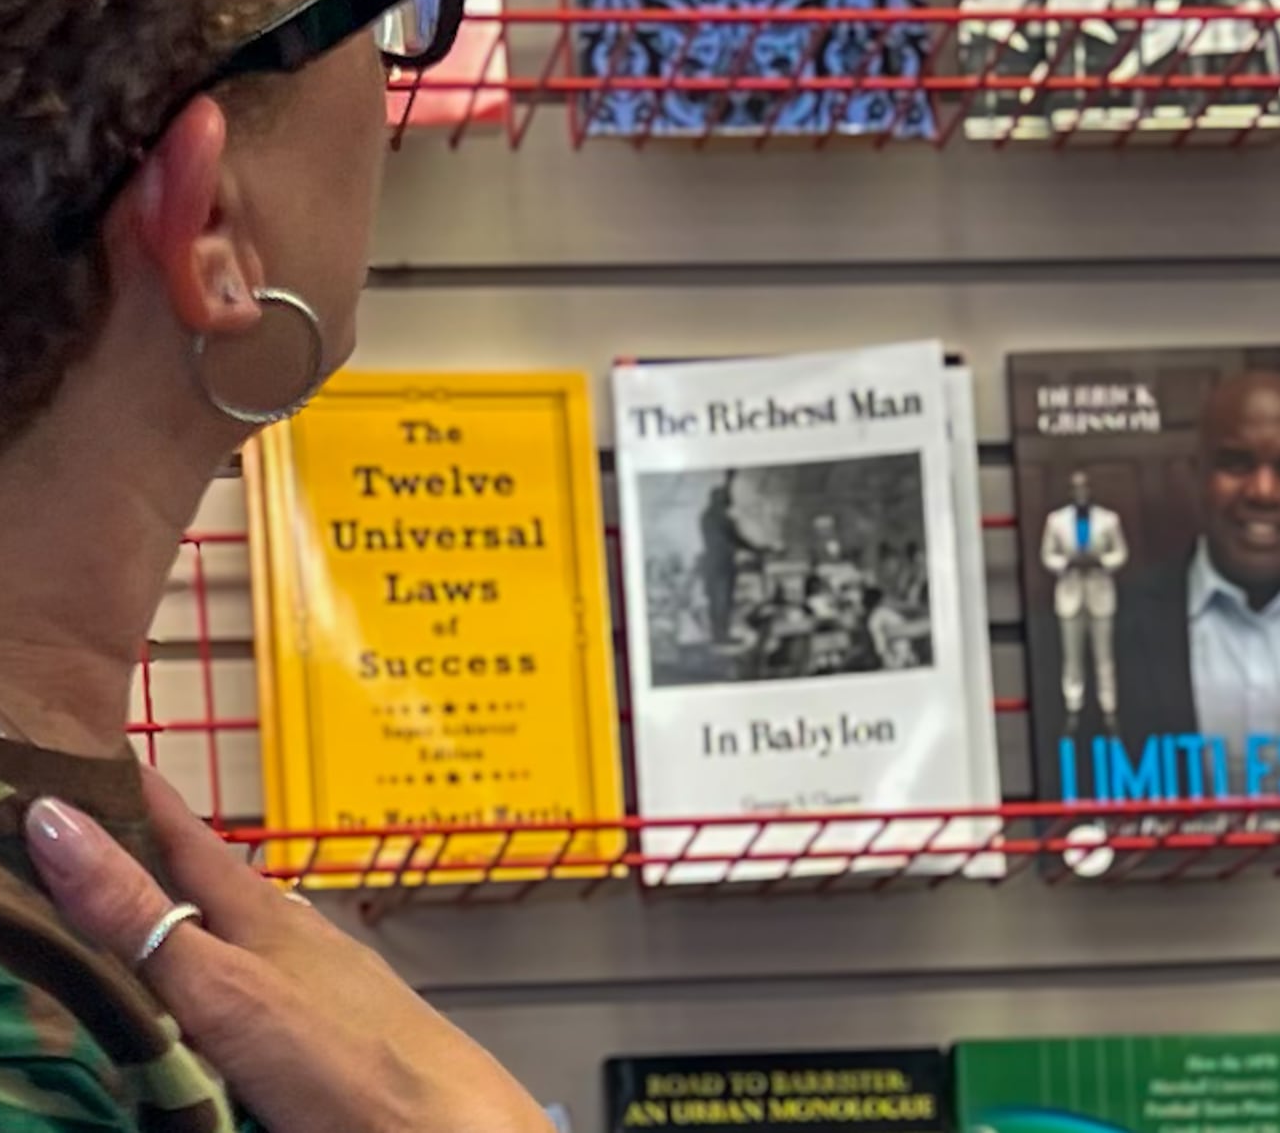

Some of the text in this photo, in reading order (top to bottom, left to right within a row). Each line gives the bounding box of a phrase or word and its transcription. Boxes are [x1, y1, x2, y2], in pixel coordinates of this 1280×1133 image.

[631, 388, 923, 438] The Richest Man
[1036, 383, 1158, 411] DERRICK
[400, 420, 464, 444] The
[354, 465, 516, 498] Twelve
[331, 518, 547, 552] Universal
[384, 572, 501, 605] Laws
[431, 615, 460, 638] of
[358, 649, 538, 682] Success
[701, 716, 896, 758] In Babylon
[645, 1071, 726, 1098] ROAD
[729, 1070, 770, 1097] TO
[624, 1092, 936, 1127] AN URBAN MONOLOGUE
